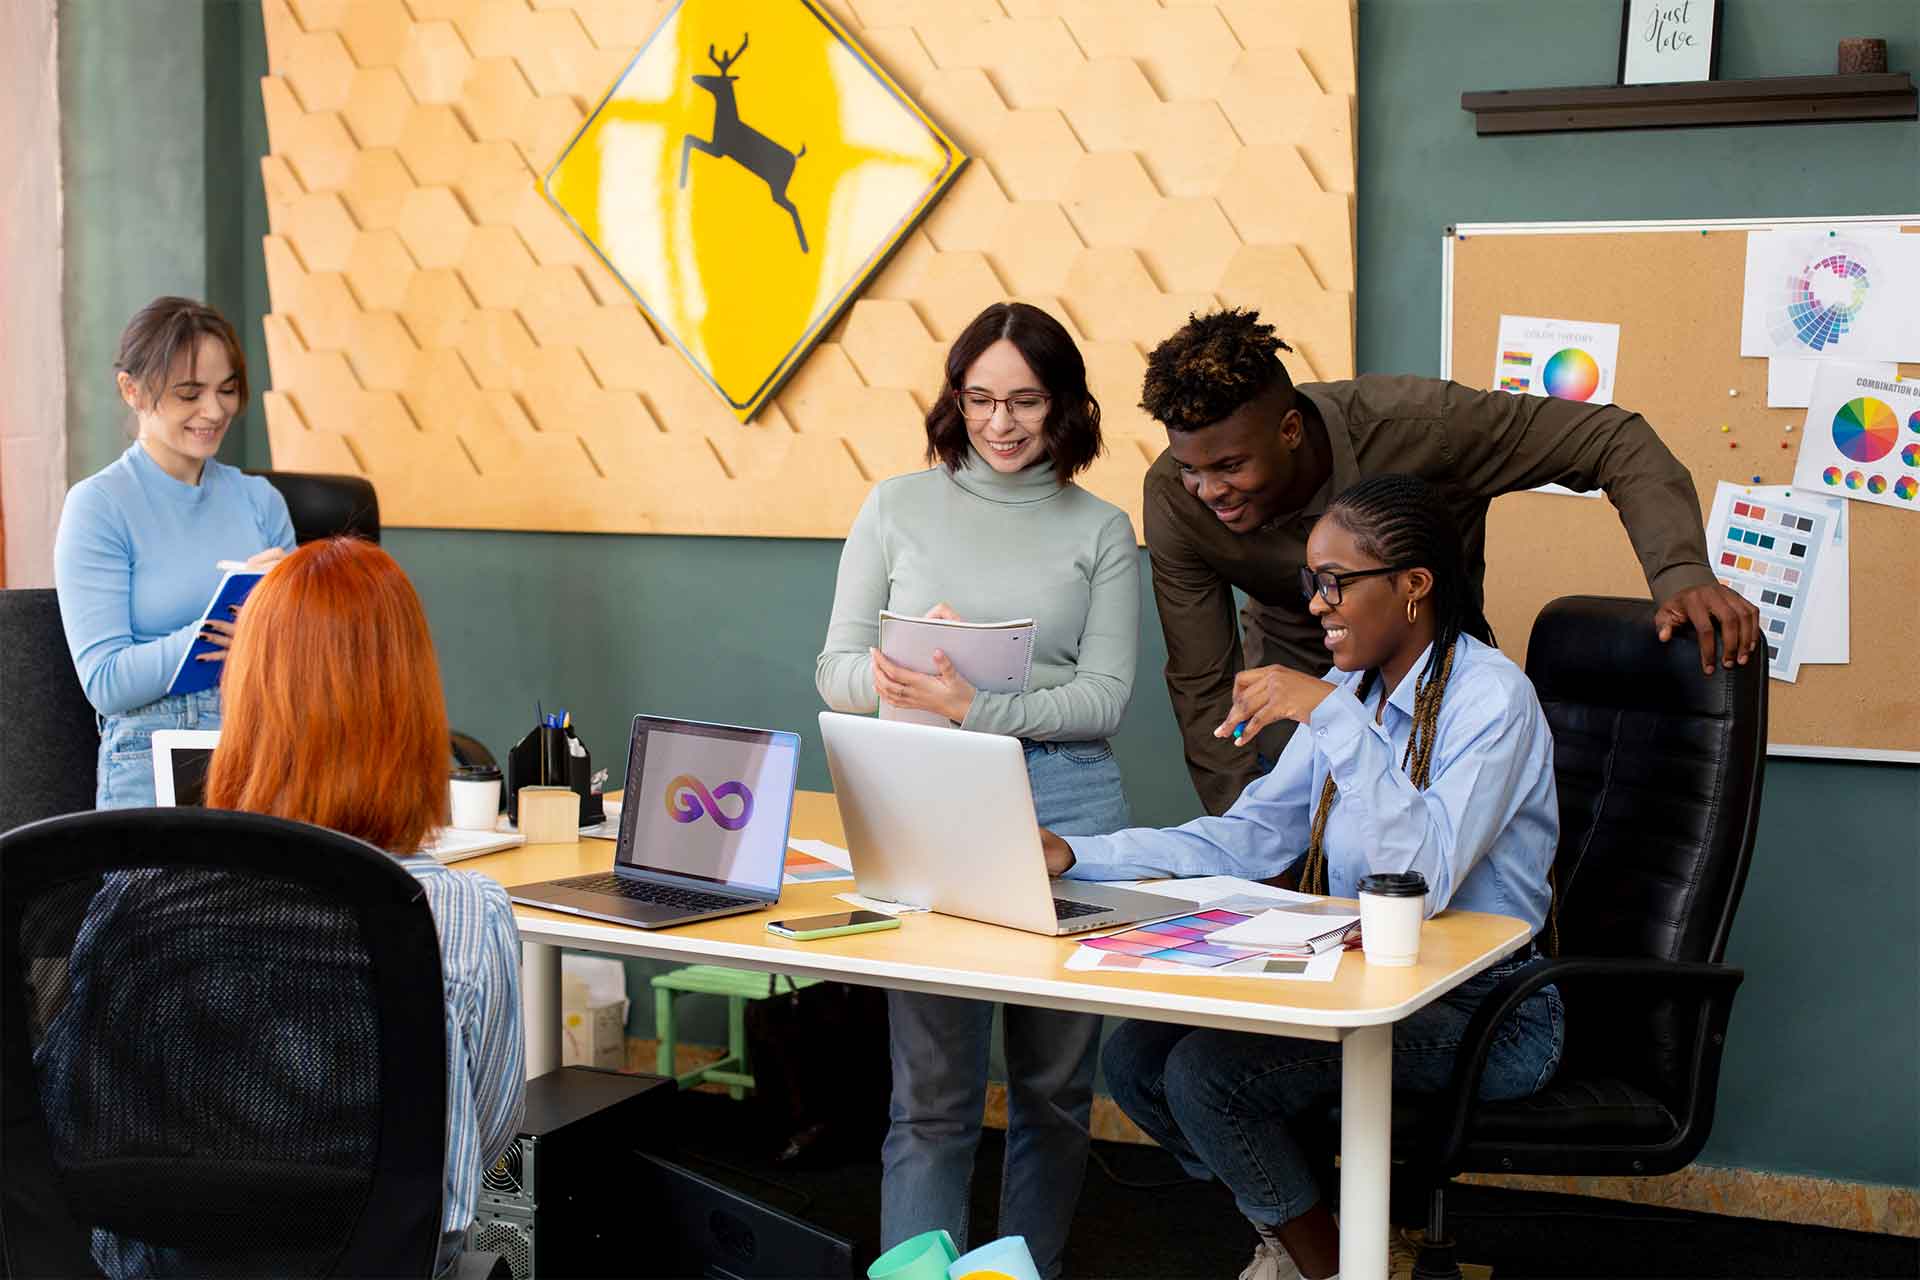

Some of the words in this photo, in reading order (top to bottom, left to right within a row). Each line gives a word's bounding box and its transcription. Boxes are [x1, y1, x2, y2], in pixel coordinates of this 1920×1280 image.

[1645, 0, 1690, 41] just
[1656, 20, 1698, 53] love
[1856, 377, 1912, 396] COMBINATION
